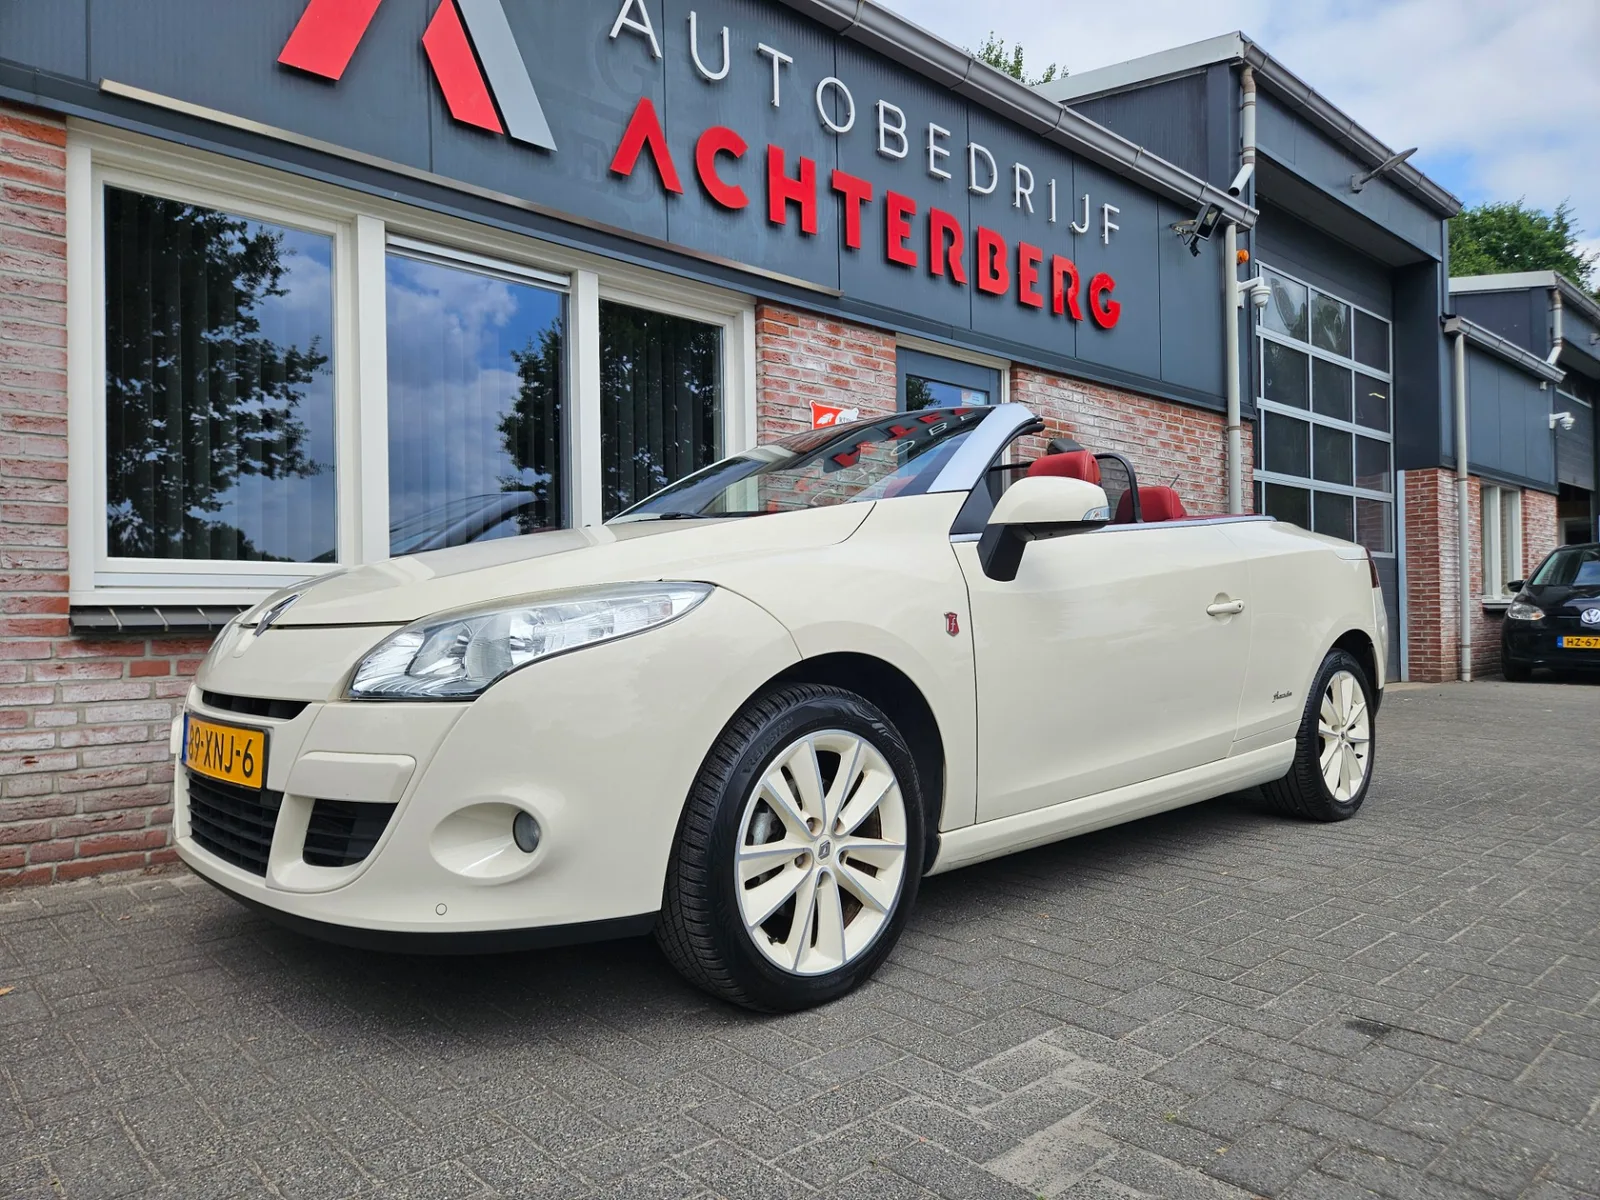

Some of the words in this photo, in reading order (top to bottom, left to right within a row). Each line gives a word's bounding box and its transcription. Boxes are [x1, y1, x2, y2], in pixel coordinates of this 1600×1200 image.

[608, 0, 1121, 245] AUTOBEDRIJF
[609, 96, 1122, 330] ACHTERBERG
[188, 724, 254, 778] 89-XNJ-6
